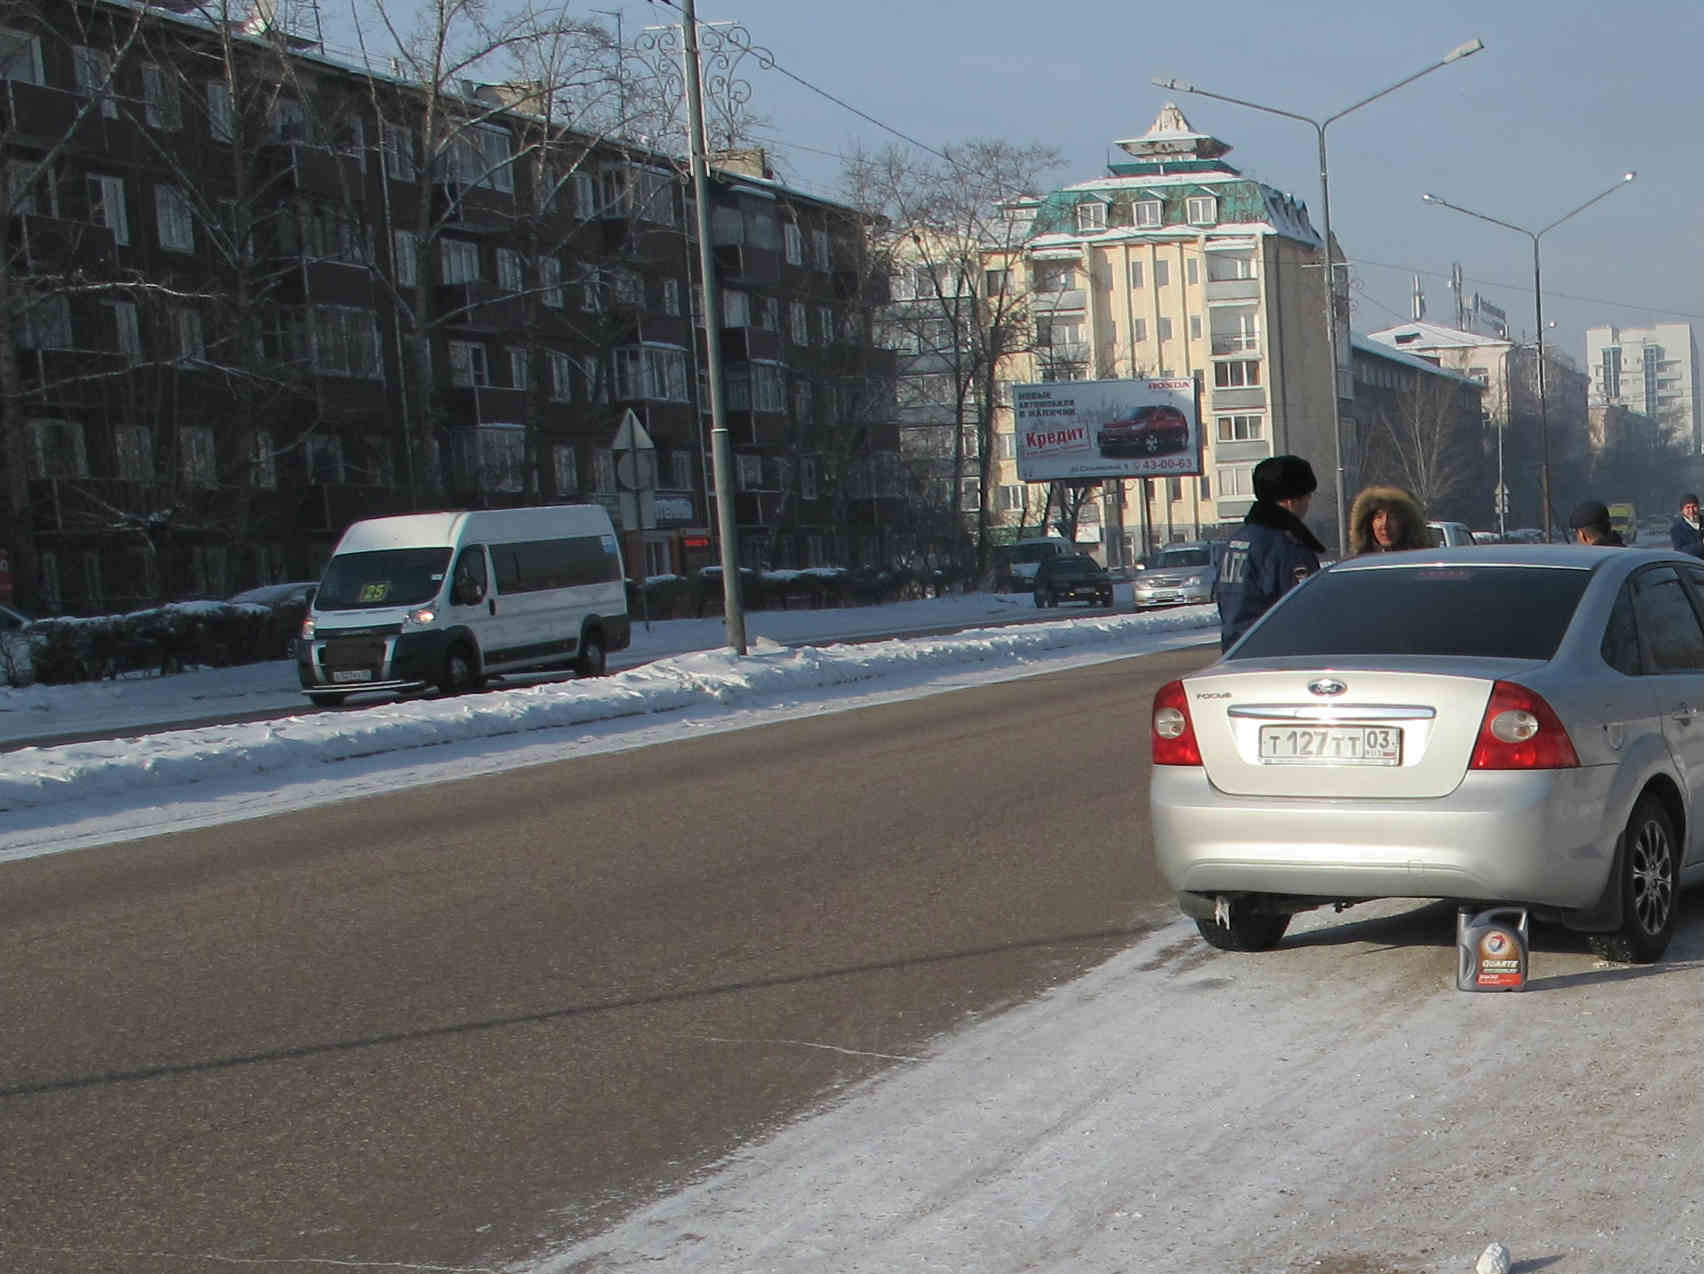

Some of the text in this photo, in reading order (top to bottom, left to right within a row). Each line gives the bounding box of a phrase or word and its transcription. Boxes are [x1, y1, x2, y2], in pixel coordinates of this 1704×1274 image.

[1026, 427, 1086, 449] Кредит
[1143, 459, 1193, 471] 43-00-63
[1366, 730, 1390, 749] 03
